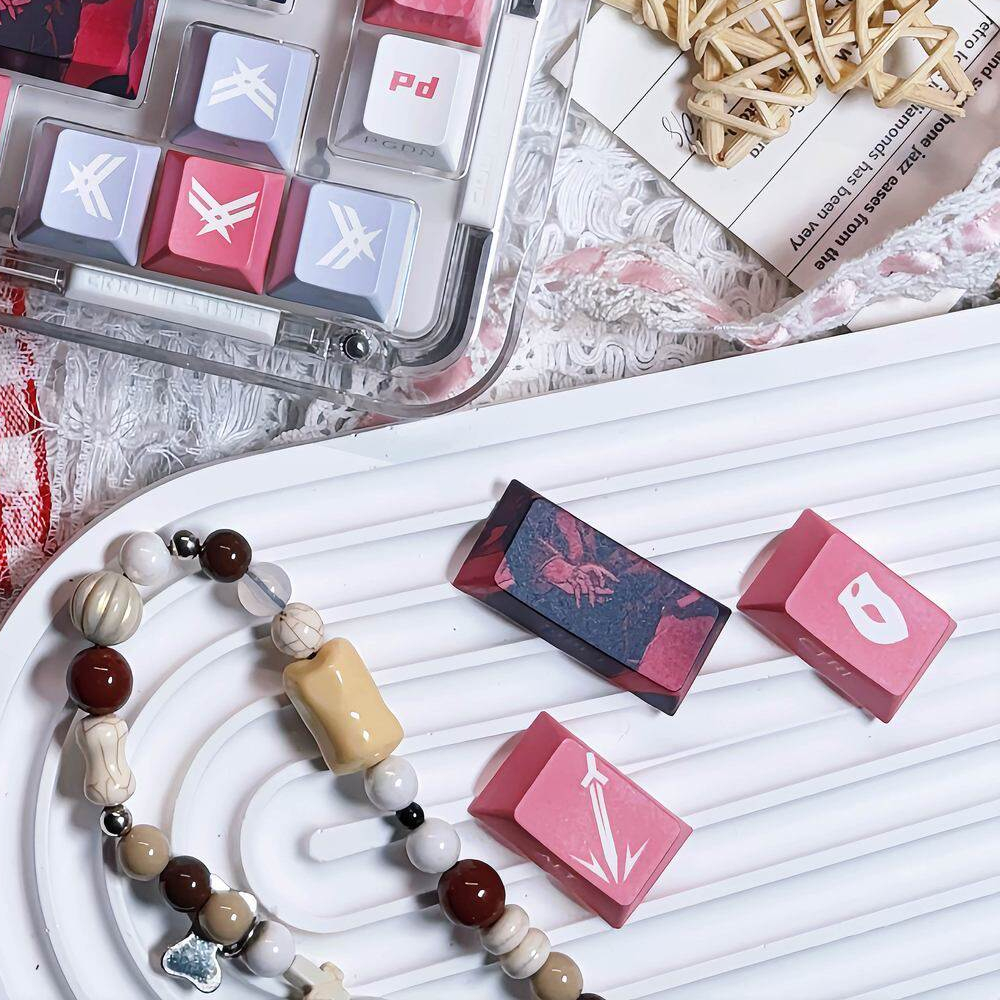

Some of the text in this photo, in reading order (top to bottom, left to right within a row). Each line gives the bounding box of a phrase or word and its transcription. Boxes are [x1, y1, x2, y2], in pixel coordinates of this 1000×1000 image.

[389, 71, 439, 99] Pd
[364, 135, 437, 158] PGDN
[896, 144, 926, 175] jazz
[790, 104, 925, 251] iamonds has been very
[864, 176, 898, 213] eases
[835, 213, 869, 246] from
[814, 247, 839, 270] the
